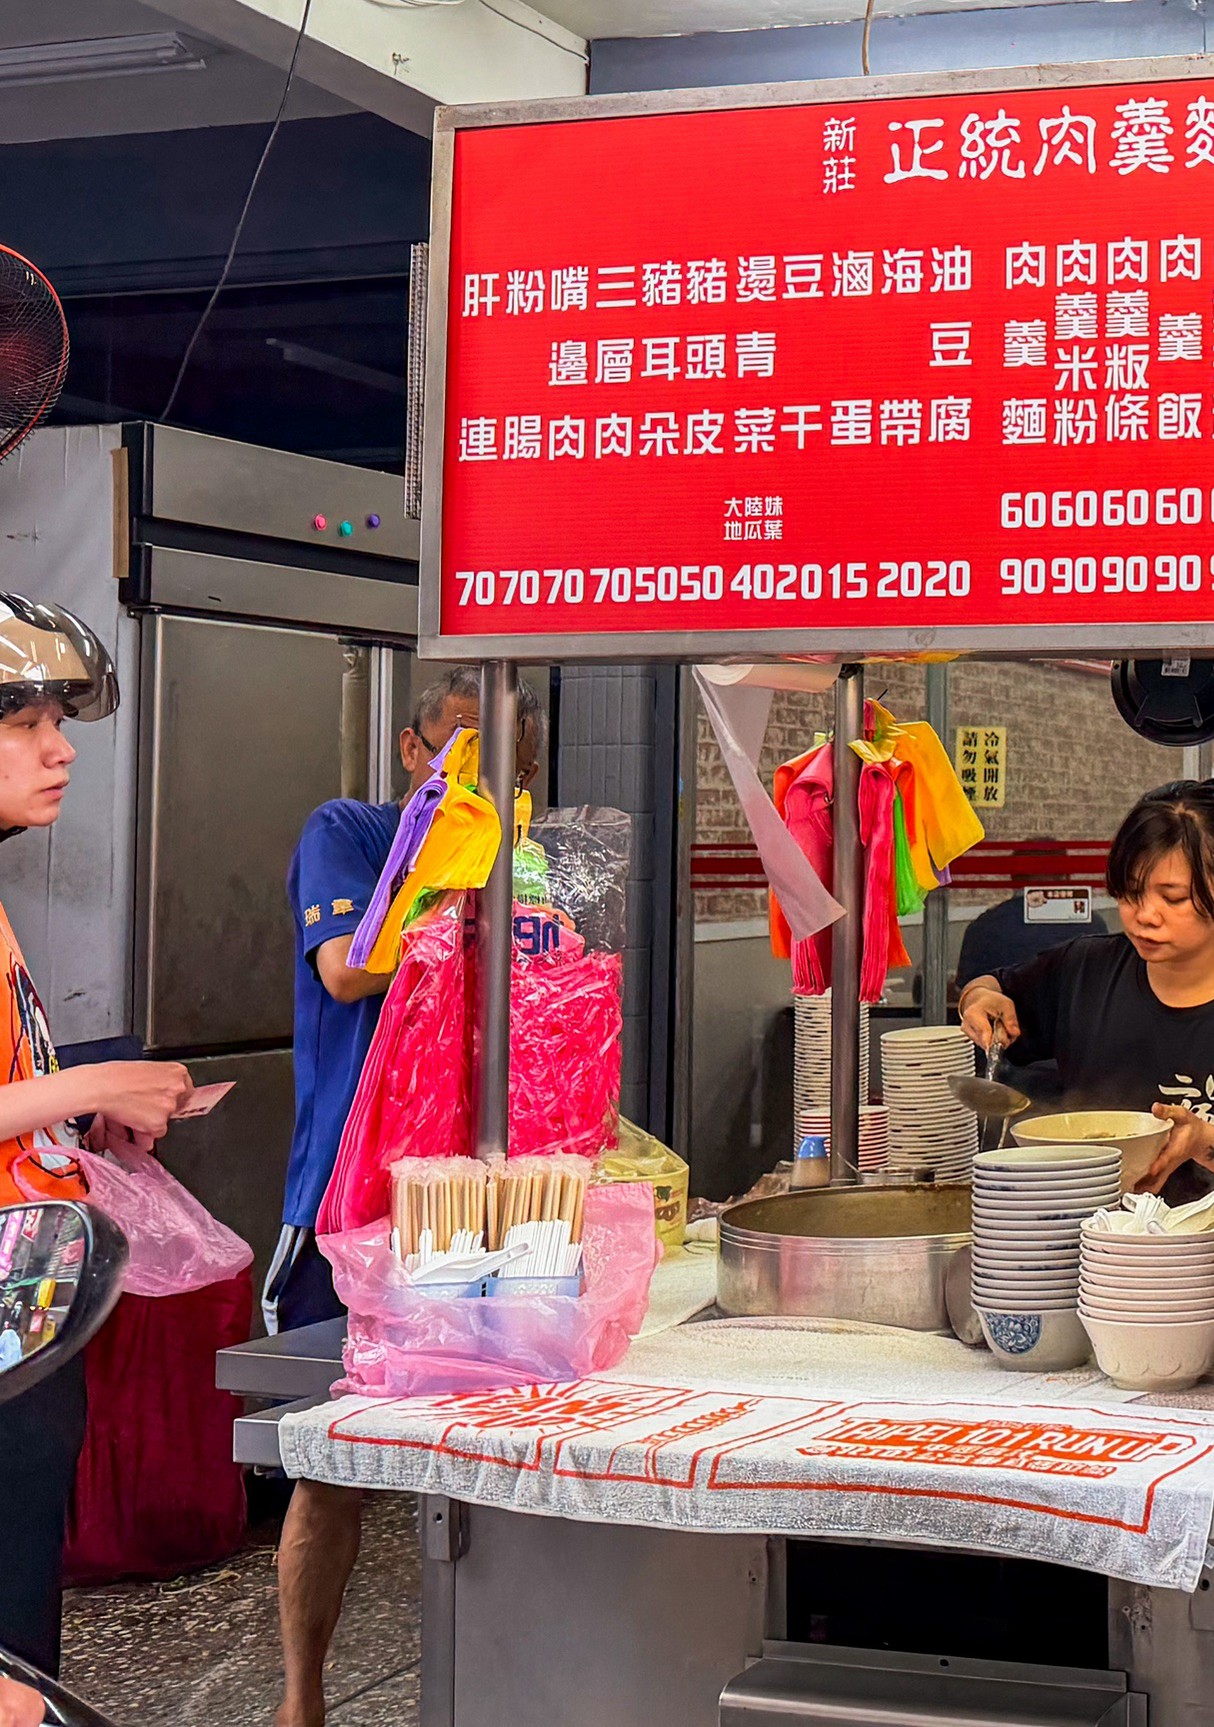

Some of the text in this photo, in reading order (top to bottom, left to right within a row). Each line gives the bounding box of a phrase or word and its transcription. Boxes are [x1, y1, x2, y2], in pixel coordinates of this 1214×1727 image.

[822, 116, 857, 194] 新莊
[724, 495, 783, 517] 大陸妹
[1001, 491, 1047, 529] 60
[1051, 490, 1098, 528] 60
[1102, 489, 1149, 526] 60
[1155, 487, 1203, 525] 60
[723, 519, 783, 541] 地瓜葉
[455, 560, 971, 606] 70 70 70 70 50 50 40 20 15 20 20
[1000, 558, 1046, 595] 90
[1051, 556, 1097, 594] 90
[1102, 555, 1148, 593] 90
[1154, 554, 1202, 592] 90
[984, 731, 1000, 801] 冷氣開放
[814, 1418, 960, 1443] TAIPEI
